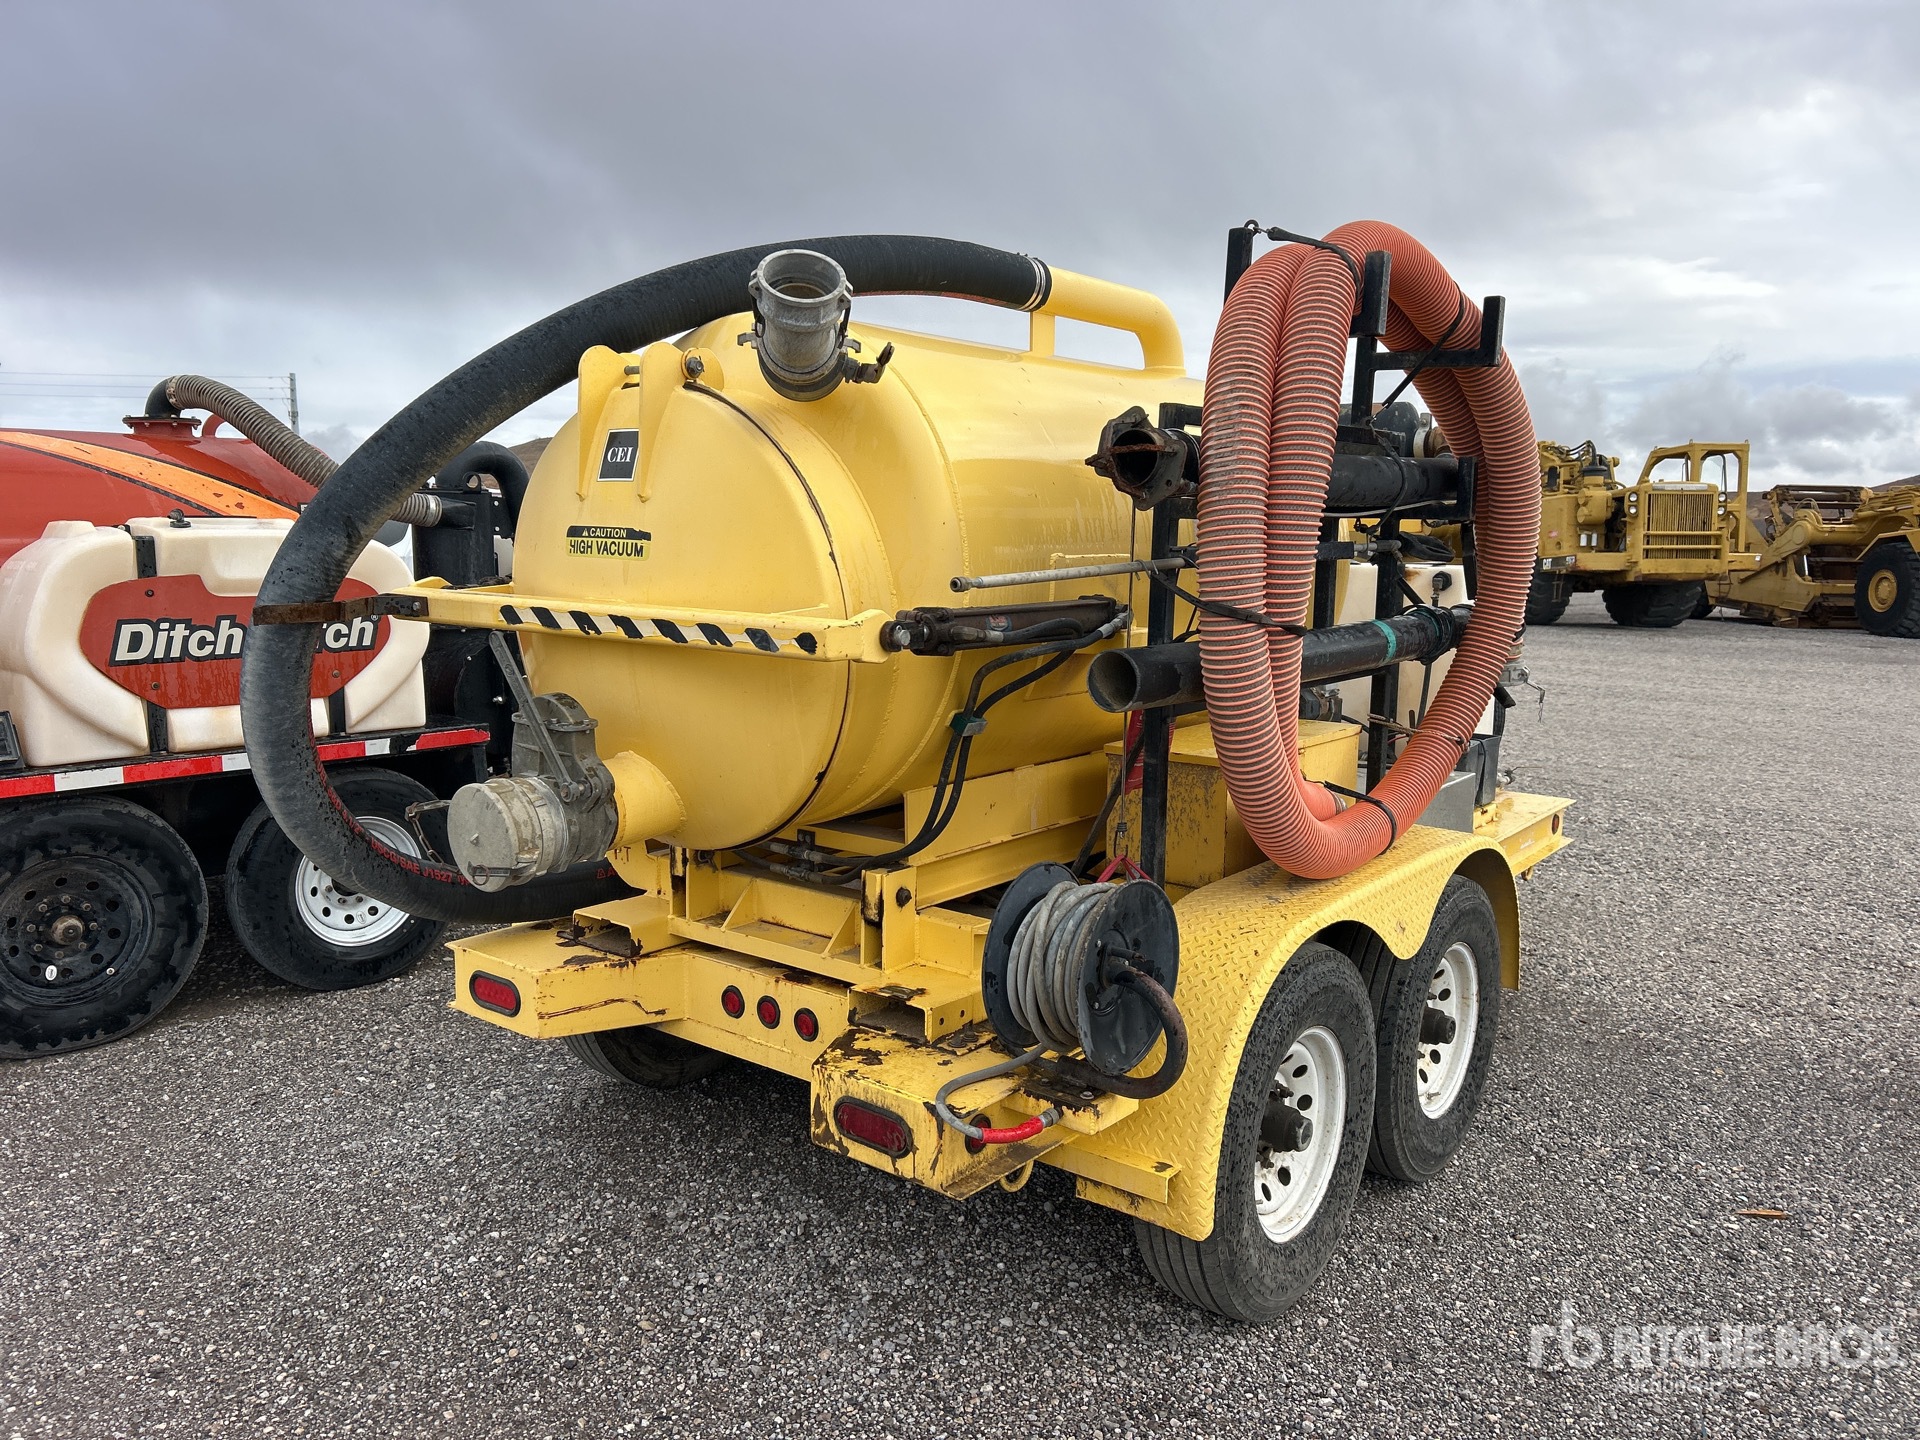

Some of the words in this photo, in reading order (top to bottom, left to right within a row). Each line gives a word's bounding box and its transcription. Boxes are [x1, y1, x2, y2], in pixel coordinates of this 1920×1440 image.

[607, 446, 634, 463] CEI
[589, 527, 627, 538] CAUTION
[569, 539, 593, 555] HIGH
[596, 540, 644, 558] VACUUM
[114, 618, 244, 662] Ditch
[371, 836, 421, 874] USCG/SAE
[422, 866, 453, 883] J1527
